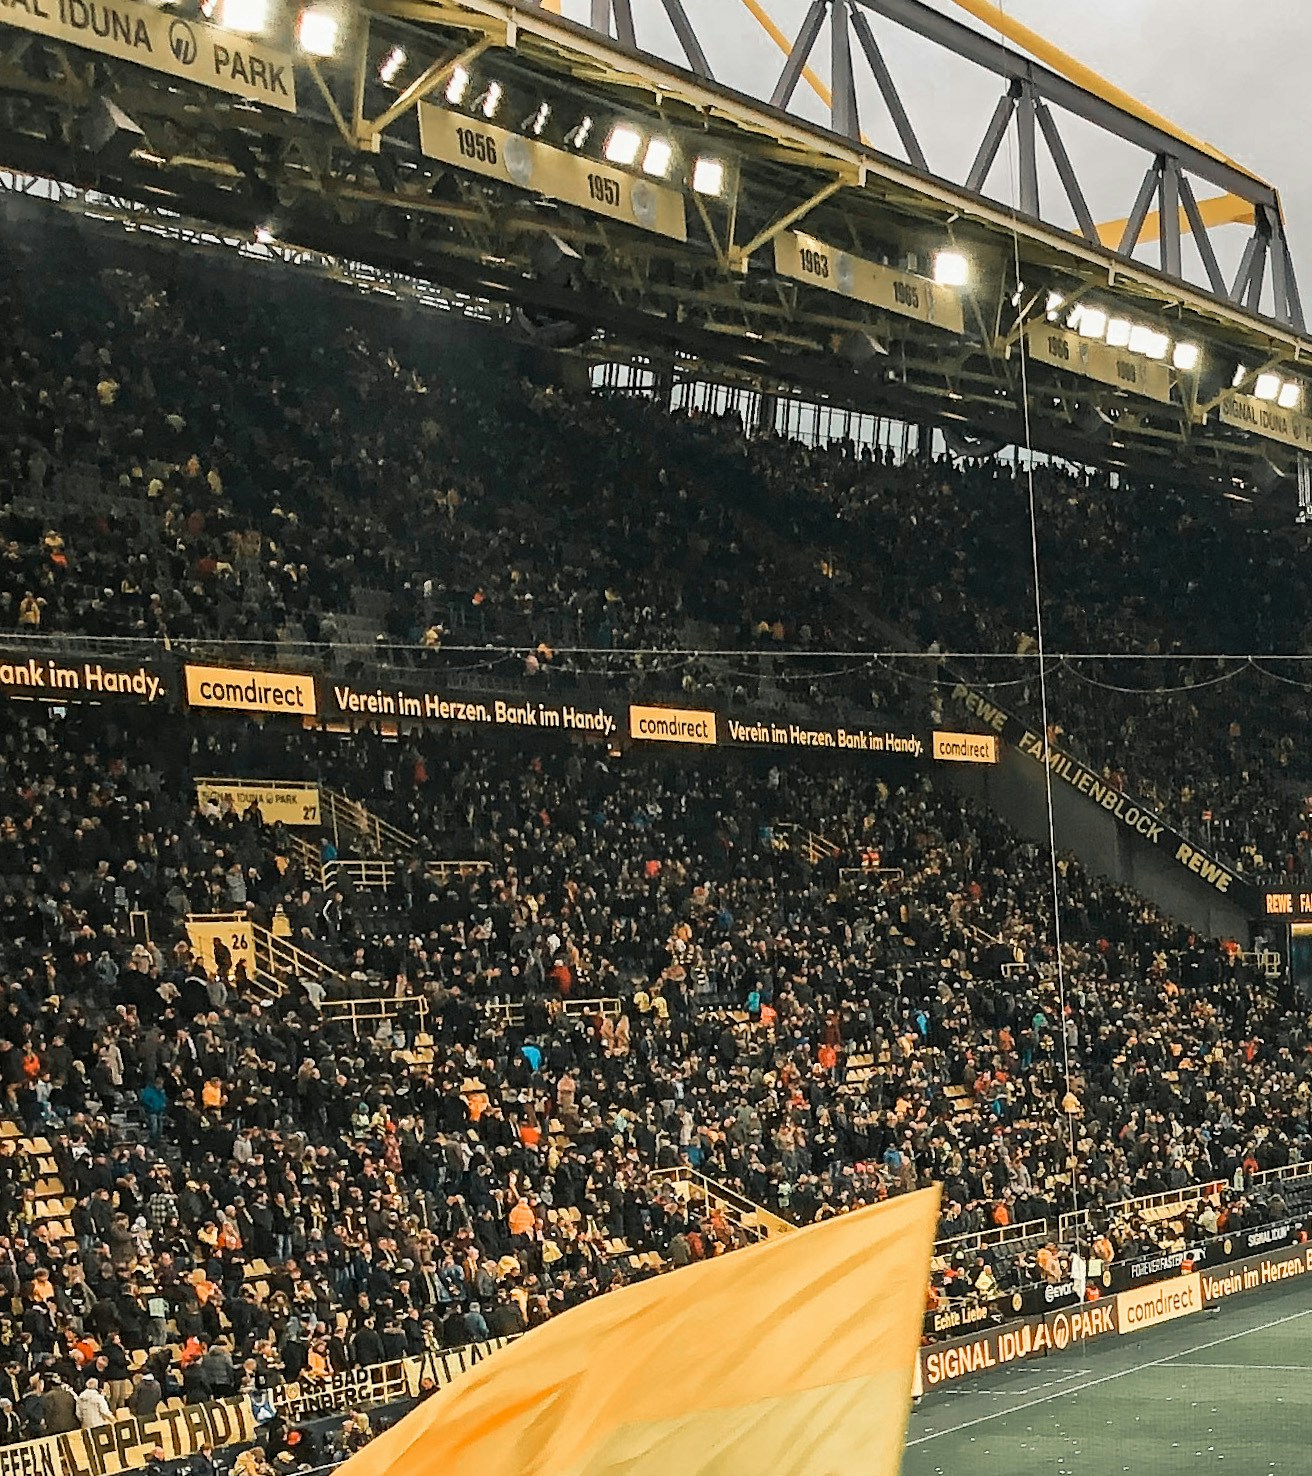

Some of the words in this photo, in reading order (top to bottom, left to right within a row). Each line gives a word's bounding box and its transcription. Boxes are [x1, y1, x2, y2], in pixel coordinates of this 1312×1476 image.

[59, 0, 153, 53] IDUNA
[213, 43, 288, 96] PARK
[456, 127, 498, 166] 1956
[586, 172, 620, 208] 1957
[799, 247, 829, 279] 1963
[1223, 399, 1259, 426] SIGNAL
[1260, 411, 1288, 434] IDUNA
[51, 664, 79, 688] im
[86, 665, 166, 703] Handy.
[200, 678, 304, 708] comdirect
[334, 687, 394, 715] Verein
[399, 692, 421, 717] im
[425, 694, 493, 723] Herzen.
[494, 700, 536, 727] Bank
[539, 705, 560, 728] im
[563, 706, 617, 735] Handy.
[639, 716, 709, 738] comdirect
[728, 720, 770, 744] Verein
[771, 723, 787, 744] im
[789, 725, 836, 748] Herzen.
[838, 727, 868, 749] Bank
[870, 730, 884, 750] im
[885, 731, 924, 757] Handy.
[940, 739, 989, 758] comdirect
[1018, 731, 1164, 844] FAMILIENBLOCK
[303, 806, 317, 820] 27
[1176, 843, 1233, 893] REWE
[1266, 893, 1293, 914] REWE
[231, 933, 248, 950] 26
[1203, 1269, 1242, 1301] Verein
[1244, 1265, 1259, 1288] im
[1261, 1256, 1305, 1283] Herzen.
[1127, 1285, 1194, 1323] comdirect
[927, 1339, 996, 1384] SIGNAL
[1072, 1304, 1115, 1341] PARK
[279, 1386, 371, 1420] EINBERG
